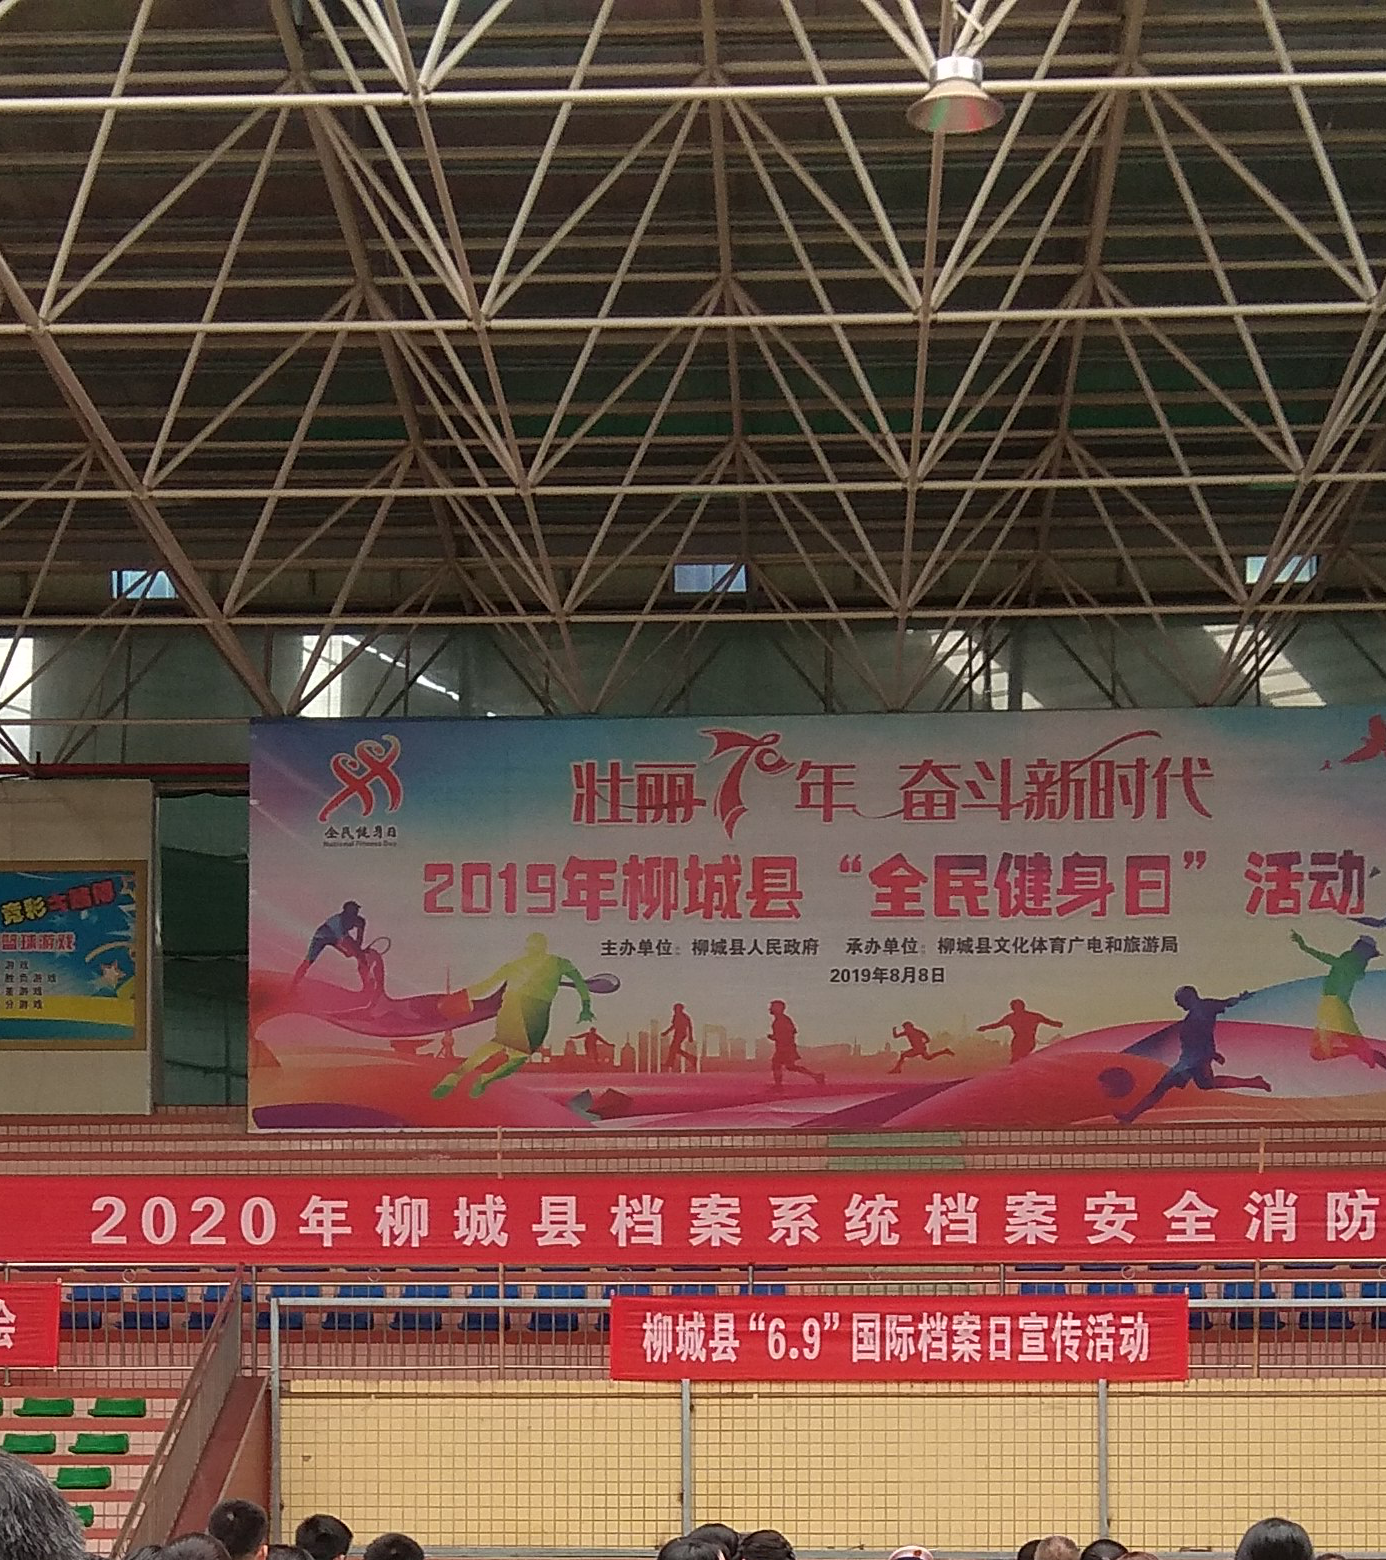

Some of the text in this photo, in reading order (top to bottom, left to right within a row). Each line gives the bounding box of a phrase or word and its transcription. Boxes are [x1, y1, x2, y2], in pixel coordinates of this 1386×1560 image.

[899, 755, 1214, 821] 奋斗新时代
[830, 966, 945, 984] 2019年8月8日
